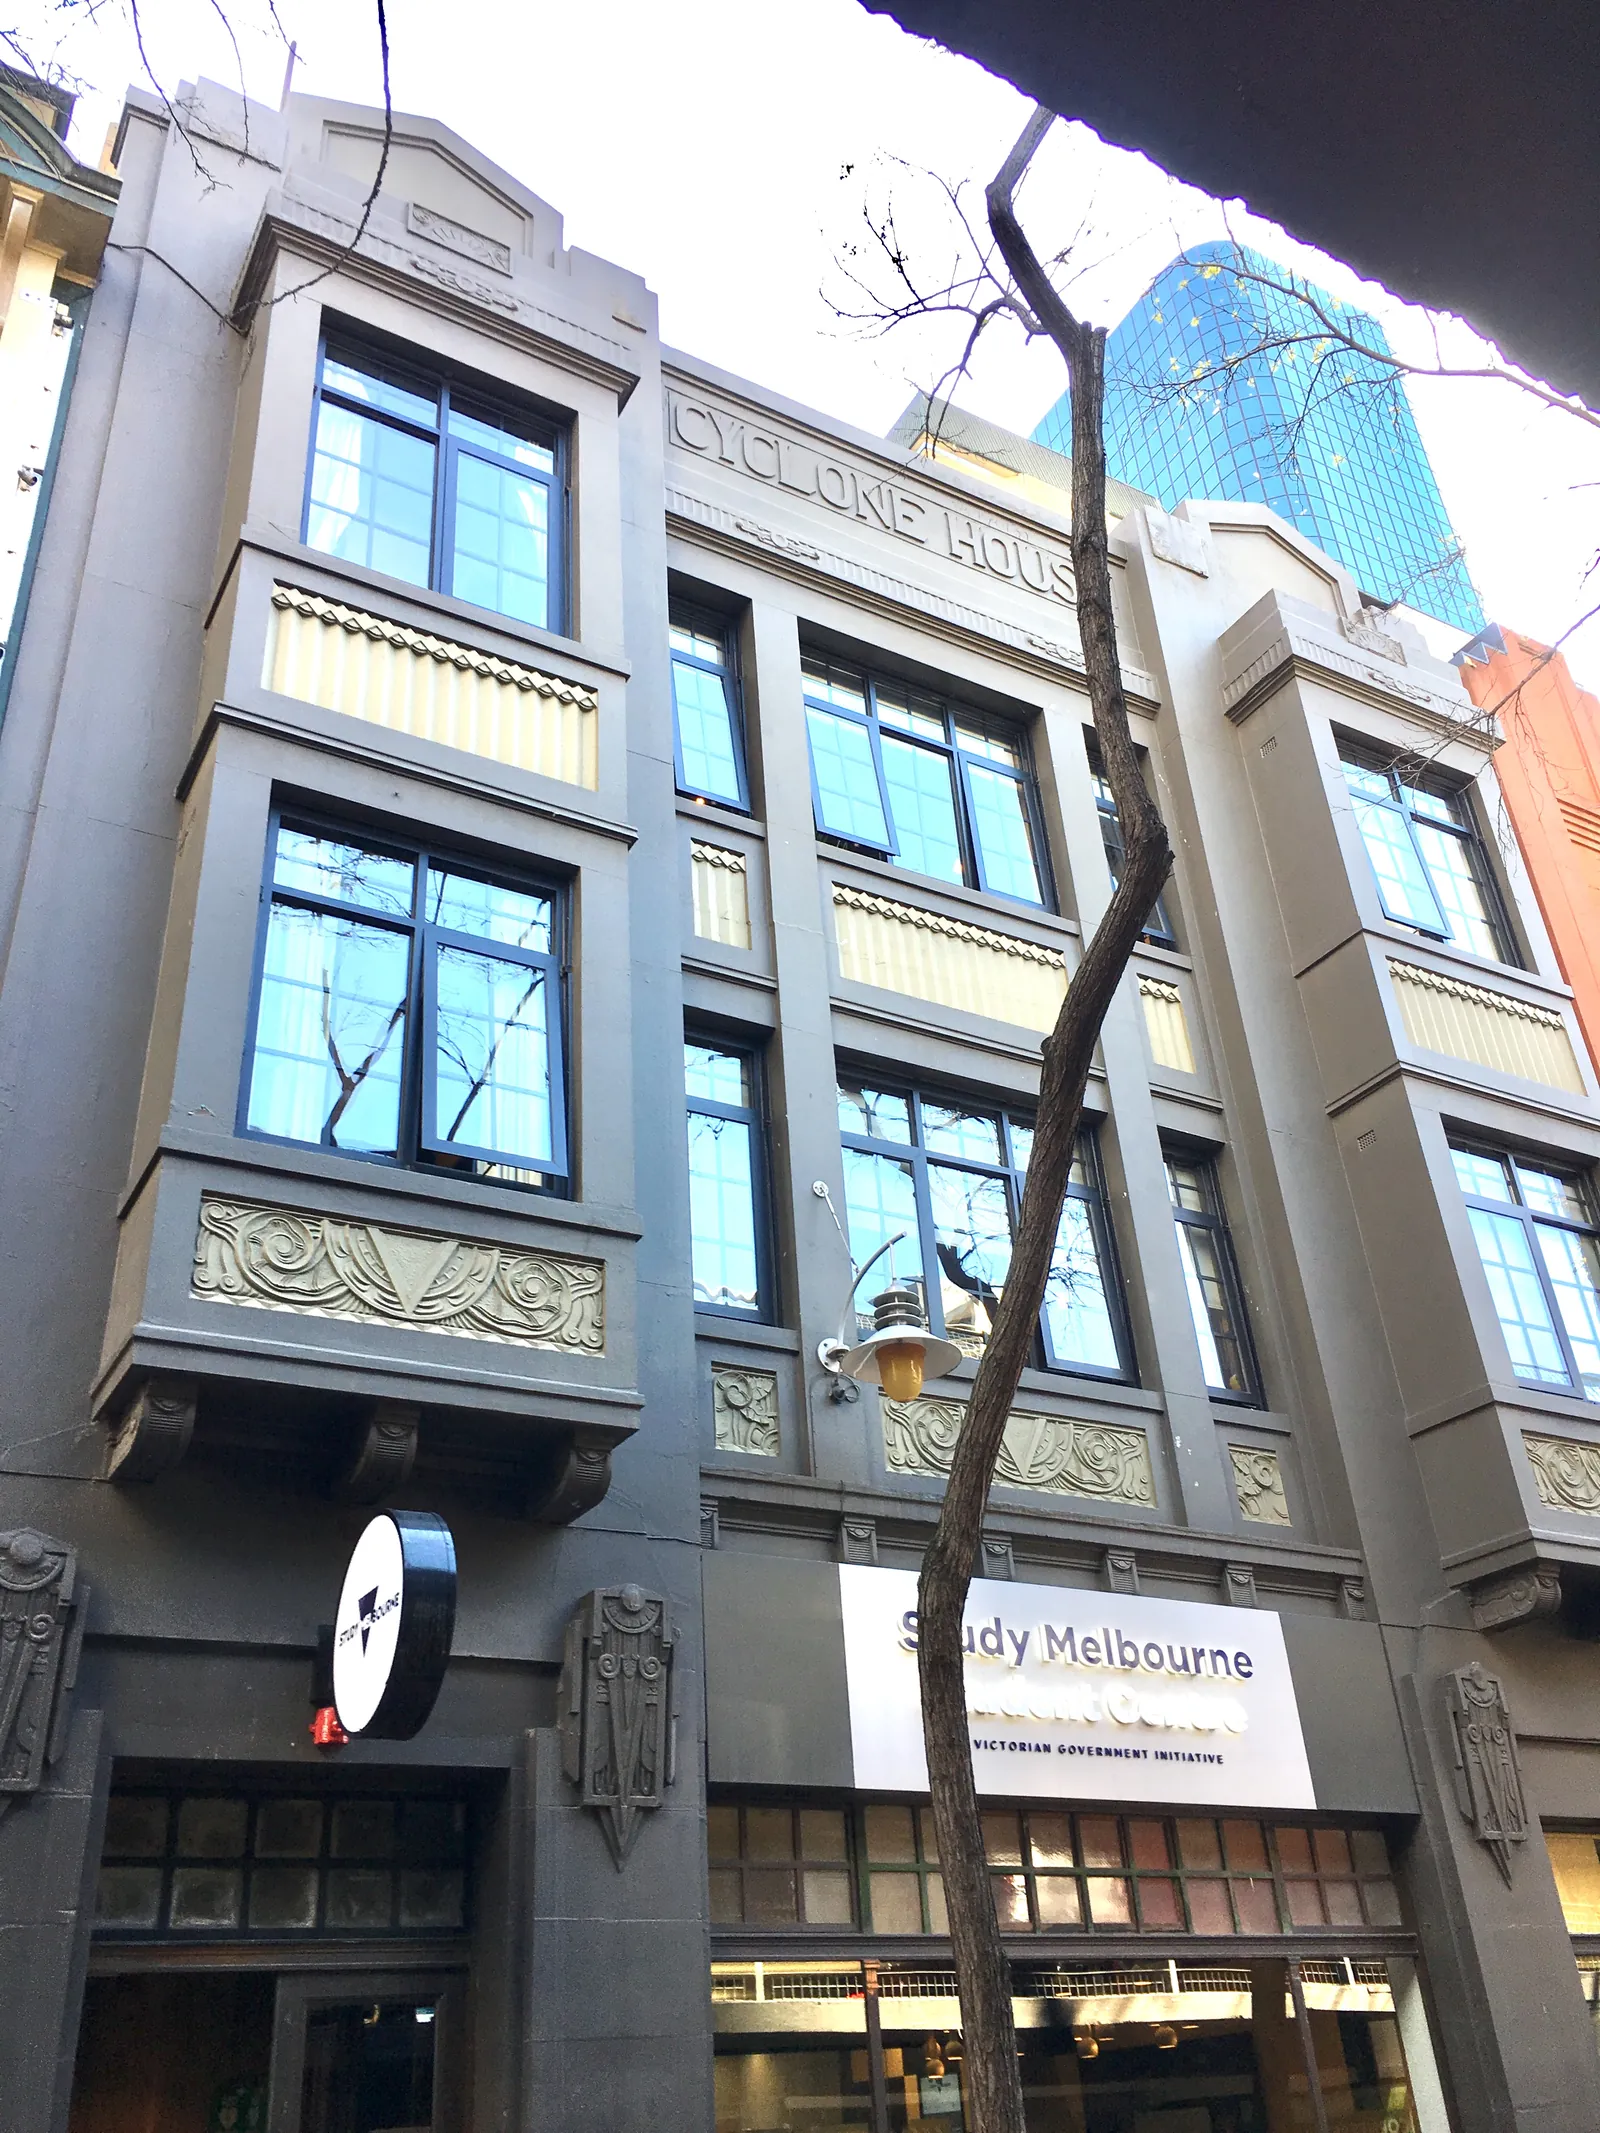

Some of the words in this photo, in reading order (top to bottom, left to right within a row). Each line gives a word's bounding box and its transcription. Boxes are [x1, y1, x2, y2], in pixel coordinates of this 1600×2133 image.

[676, 402, 928, 544] CYCLONE
[944, 511, 1078, 606] HOUS
[900, 1611, 1029, 1667] Sudy
[1043, 1624, 1253, 1680] Melbourne
[974, 1739, 1052, 1754] VICTORIAN
[1057, 1744, 1149, 1760] GOVERNMENT
[1154, 1750, 1224, 1765] INITIATIVE
